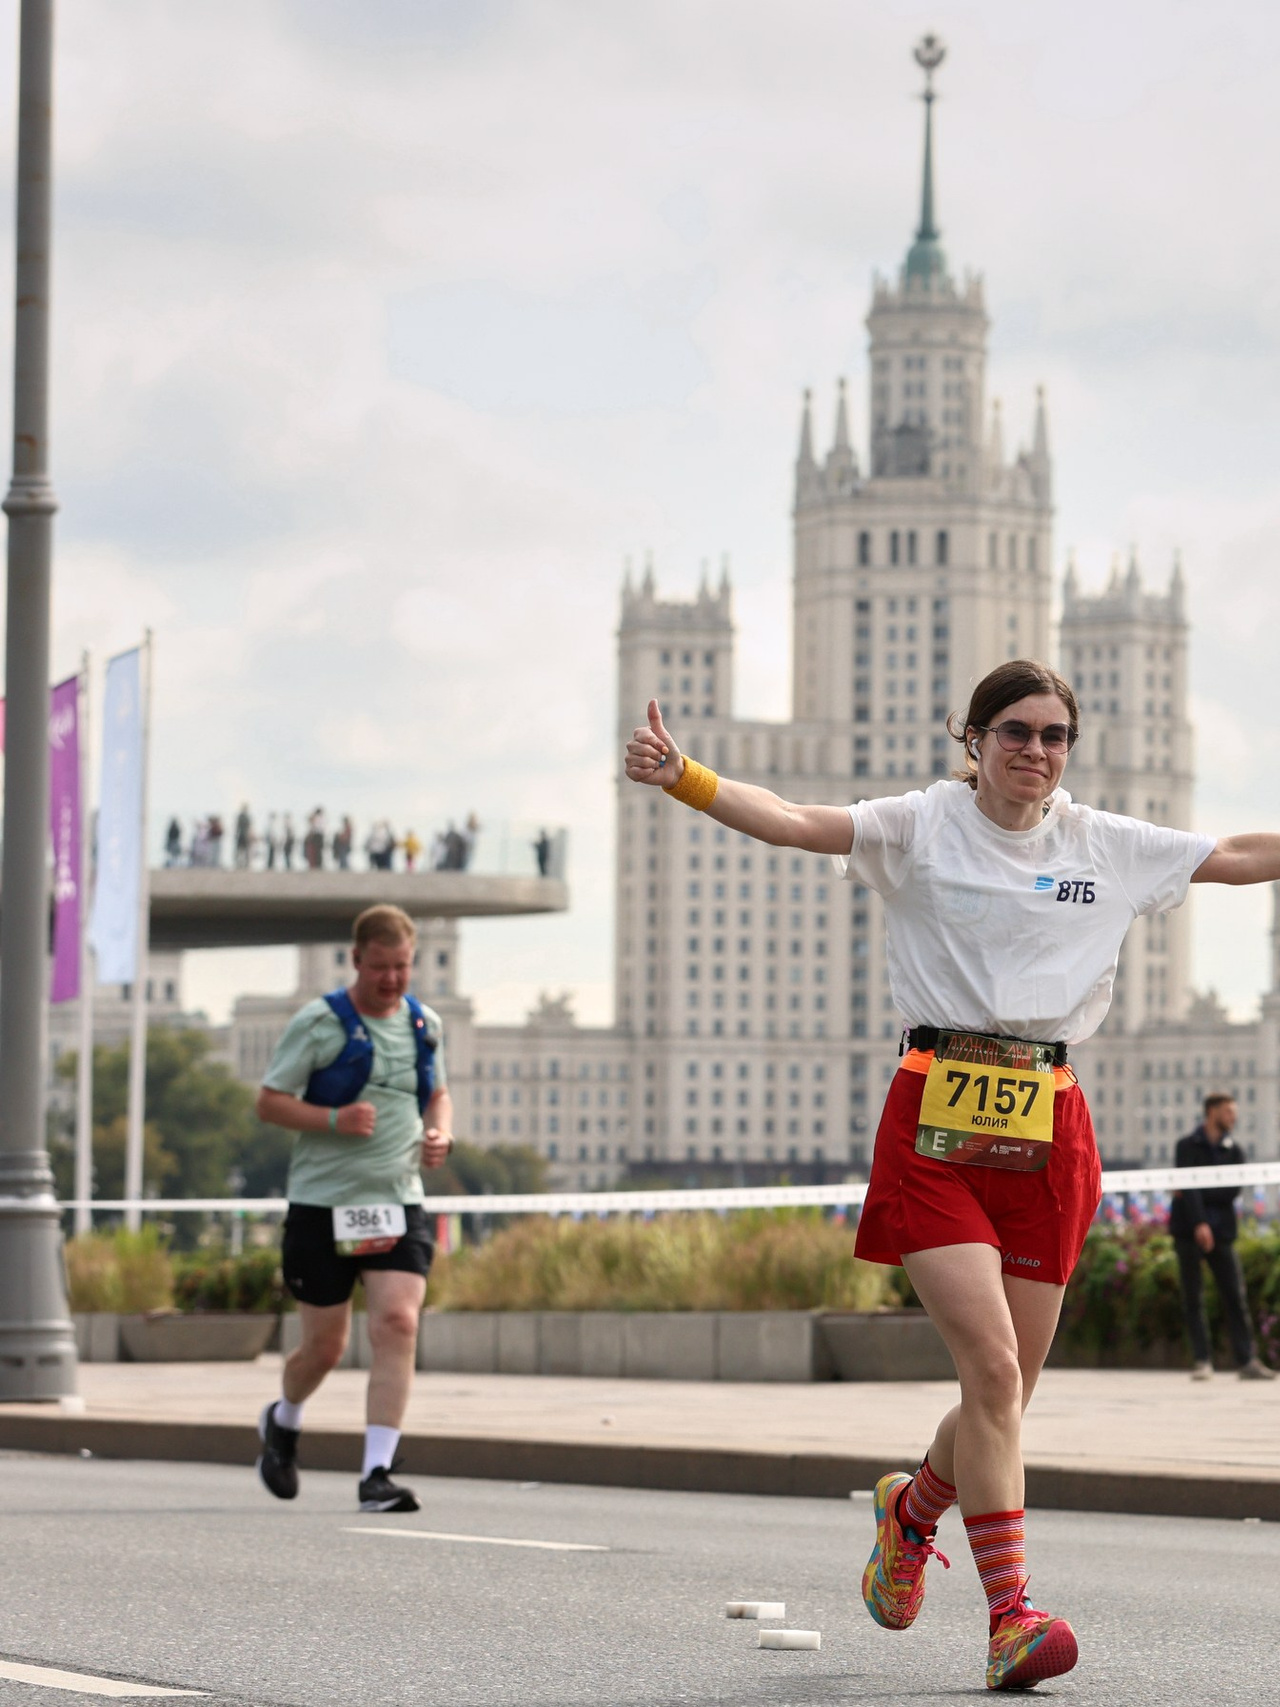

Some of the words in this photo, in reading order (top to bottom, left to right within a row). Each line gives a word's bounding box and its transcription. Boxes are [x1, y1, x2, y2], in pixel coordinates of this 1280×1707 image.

[1056, 880, 1096, 904] ВТБ
[946, 1070, 1040, 1117] 7157
[971, 1114, 1009, 1129] ЮЛИЯ
[345, 1208, 392, 1228] 3861
[1016, 1256, 1041, 1268] MAD
